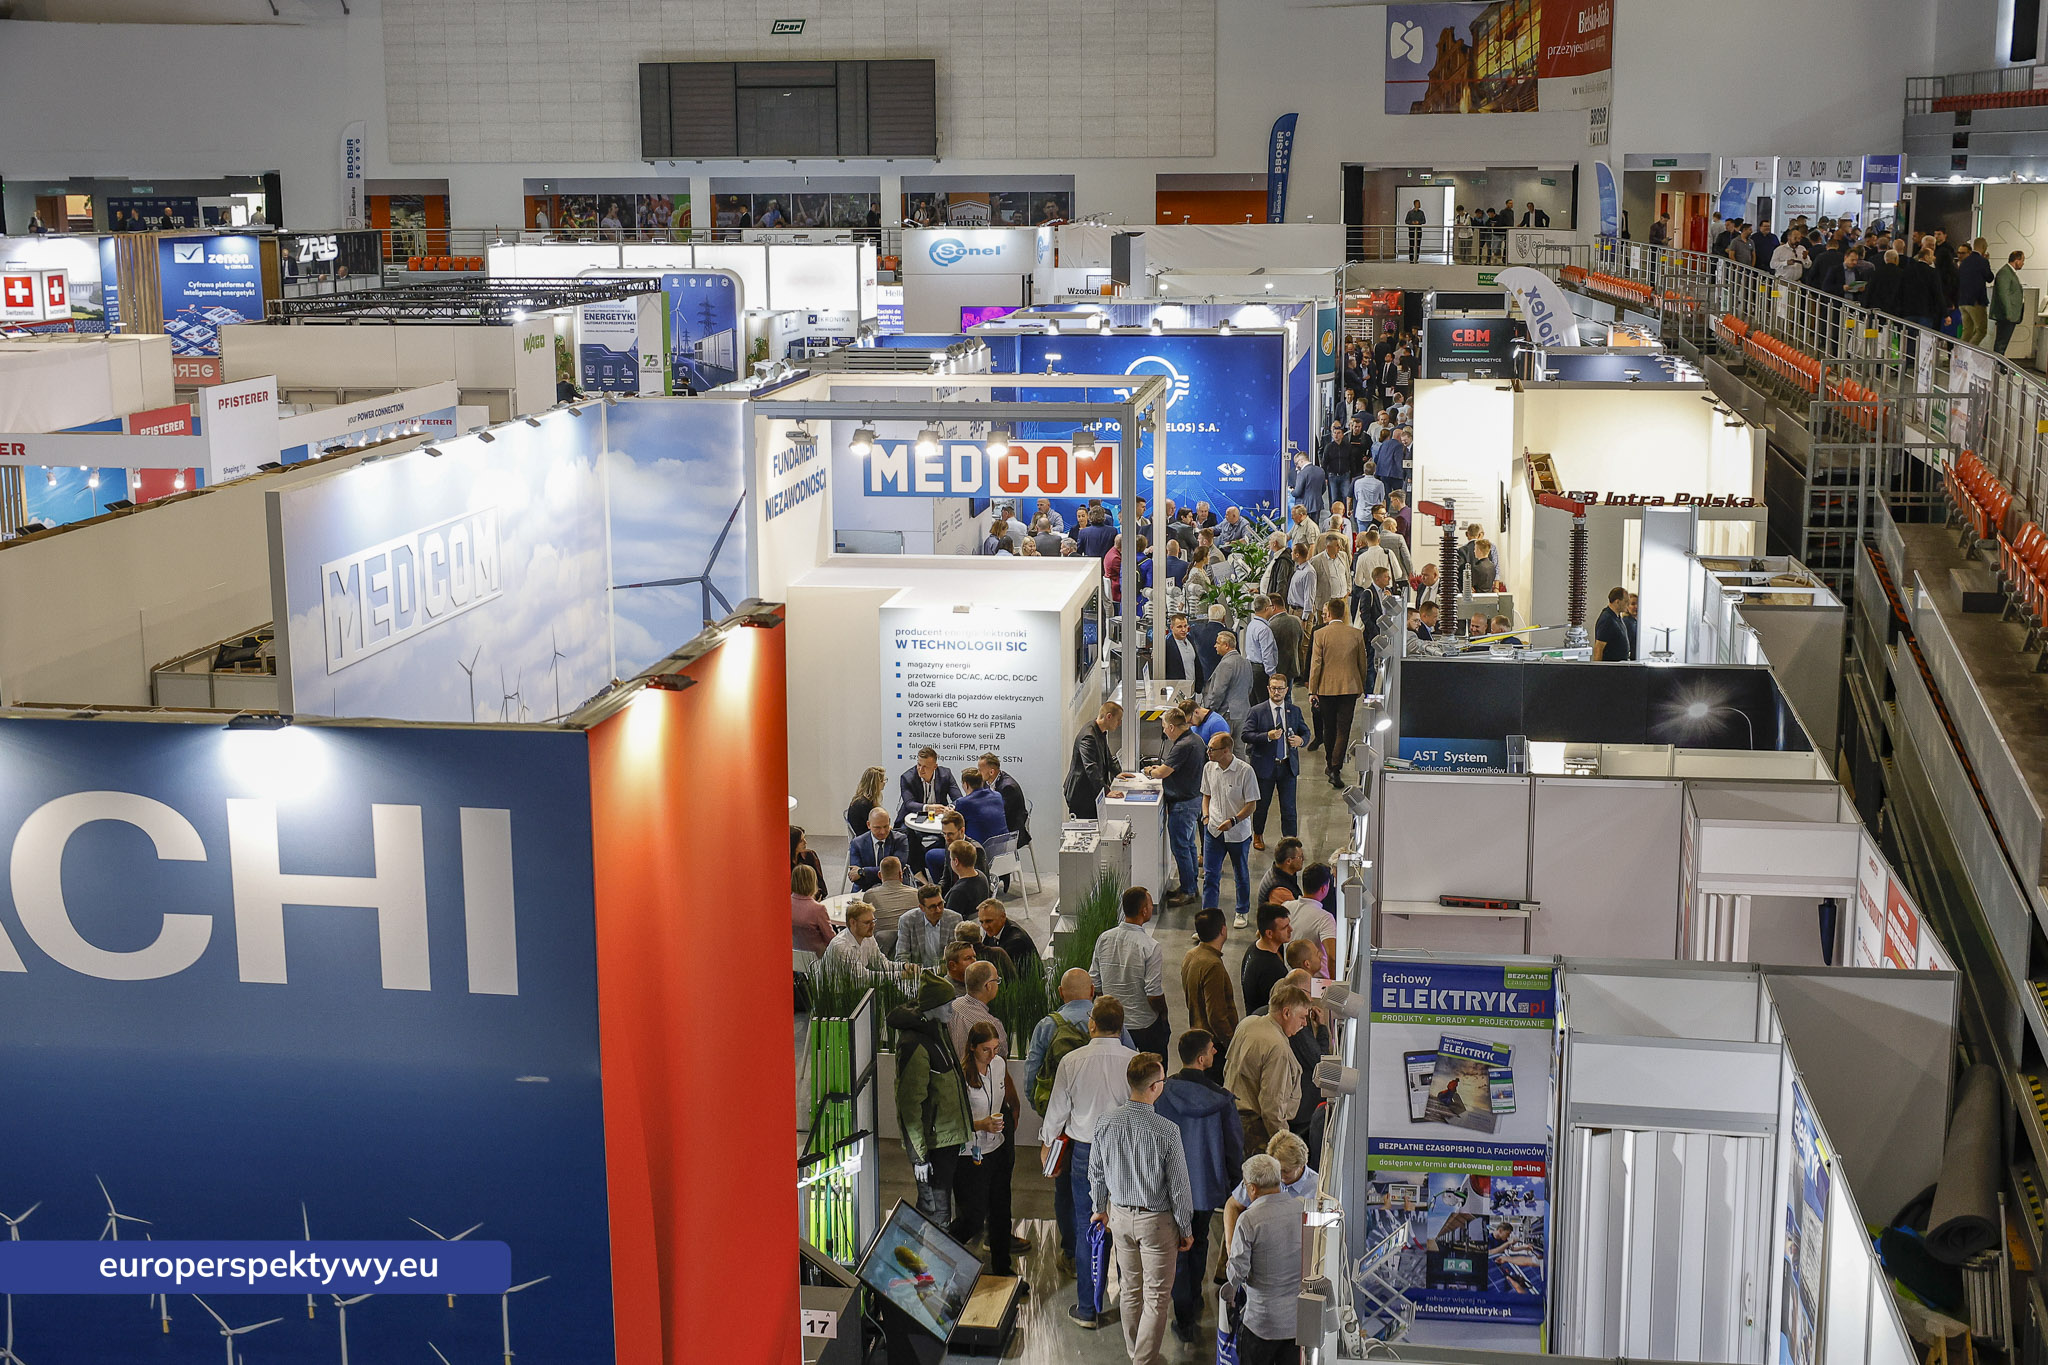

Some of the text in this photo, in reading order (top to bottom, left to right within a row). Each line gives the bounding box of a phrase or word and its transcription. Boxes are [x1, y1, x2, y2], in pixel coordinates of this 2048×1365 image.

[1275, 131, 1284, 173] BBOSiR
[941, 244, 1000, 256] Sonel
[208, 253, 249, 264] zenon
[215, 281, 244, 289] platforma
[1067, 287, 1099, 296] Wzorcuj
[183, 289, 255, 297] inteligentnej energetyki
[1452, 329, 1490, 342] CBM
[524, 333, 545, 354] WAGO
[643, 355, 658, 366] 75
[218, 391, 269, 410] PFISTERER
[357, 409, 374, 422] POWER
[375, 402, 404, 420] CONNECTION
[140, 420, 185, 436] PFISTERER
[1198, 422, 1220, 433] S.A.
[773, 435, 818, 478] FUNDAMENT
[223, 465, 240, 475] Shaping
[765, 466, 826, 522] NIEZAWODNOŚCI
[1605, 492, 1755, 507] Intra Polska
[328, 514, 499, 662] MEDCOM
[895, 628, 942, 637] producent
[895, 639, 1027, 651] W TECHNOLOGII SIC
[957, 693, 992, 702] pojazdów
[994, 694, 1044, 702] elektrycznych
[908, 712, 954, 720] przetwornice
[908, 720, 937, 728] okrętów
[1413, 751, 1488, 763] AST System
[1456, 765, 1505, 773] sterowników
[0, 790, 519, 996] CHI
[1382, 973, 1431, 986] fachowy
[1382, 988, 1518, 1013] ELEKTRYK
[1382, 1014, 1545, 1027] PRODUKTY PORADY PROJEKTOWANIE
[1443, 1043, 1495, 1061] ELEKTRYK
[1379, 1142, 1423, 1151] BEZPŁATNE
[1425, 1144, 1475, 1153] CZASOPISMO
[1493, 1147, 1544, 1156] FACHOWCÓW
[1379, 1159, 1413, 1168] dostępne
[1422, 1160, 1447, 1168] formie
[1449, 1162, 1494, 1171] drukowanej
[807, 1320, 830, 1334] 17
